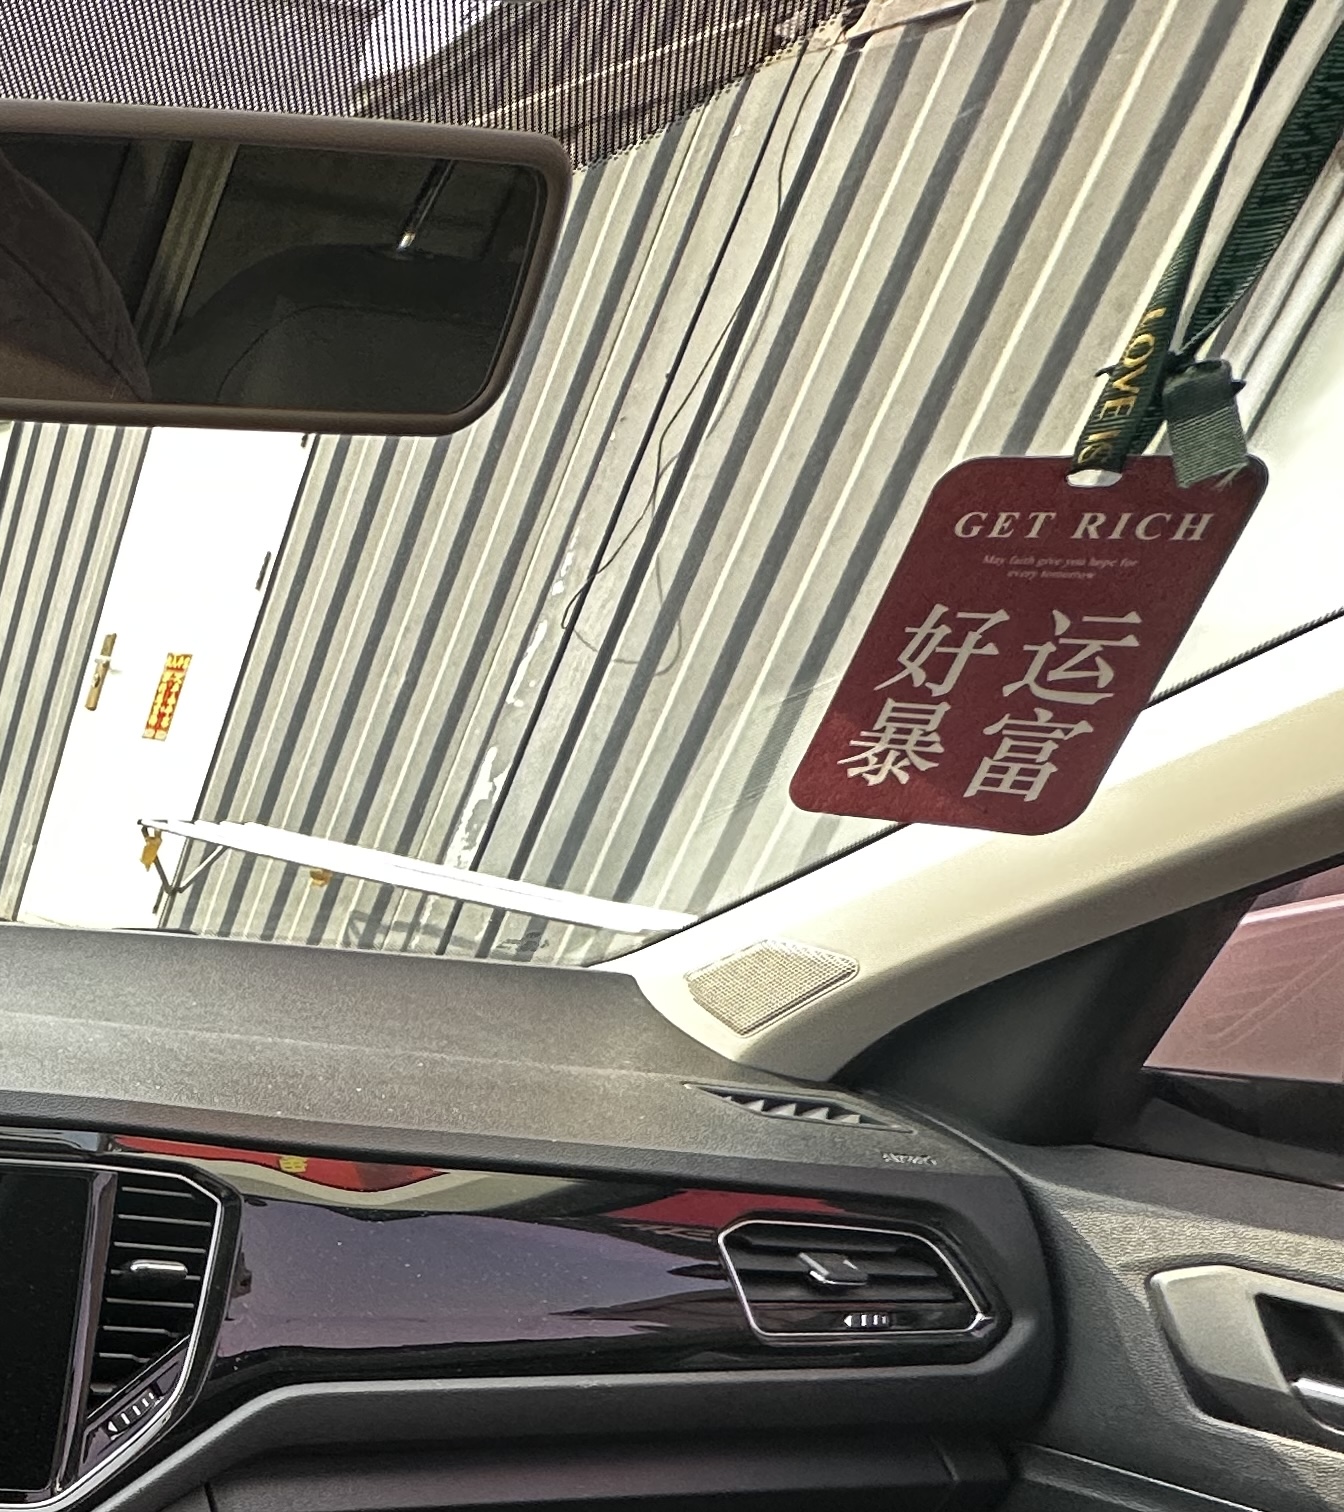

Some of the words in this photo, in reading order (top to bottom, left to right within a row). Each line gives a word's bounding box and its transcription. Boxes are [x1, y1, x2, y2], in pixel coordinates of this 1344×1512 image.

[1100, 307, 1166, 420] LOVE
[952, 511, 1056, 541] GET
[1073, 511, 1216, 542] RICH
[982, 554, 1005, 567] May
[1009, 555, 1035, 566] faith
[1036, 557, 1061, 568] give
[1064, 558, 1086, 568] you
[1088, 556, 1117, 569] hope
[1119, 557, 1138, 568] for
[1007, 570, 1038, 581] every
[1041, 570, 1096, 580] tomorrow
[875, 602, 1145, 705] 好运
[837, 697, 1094, 802] 暴富
